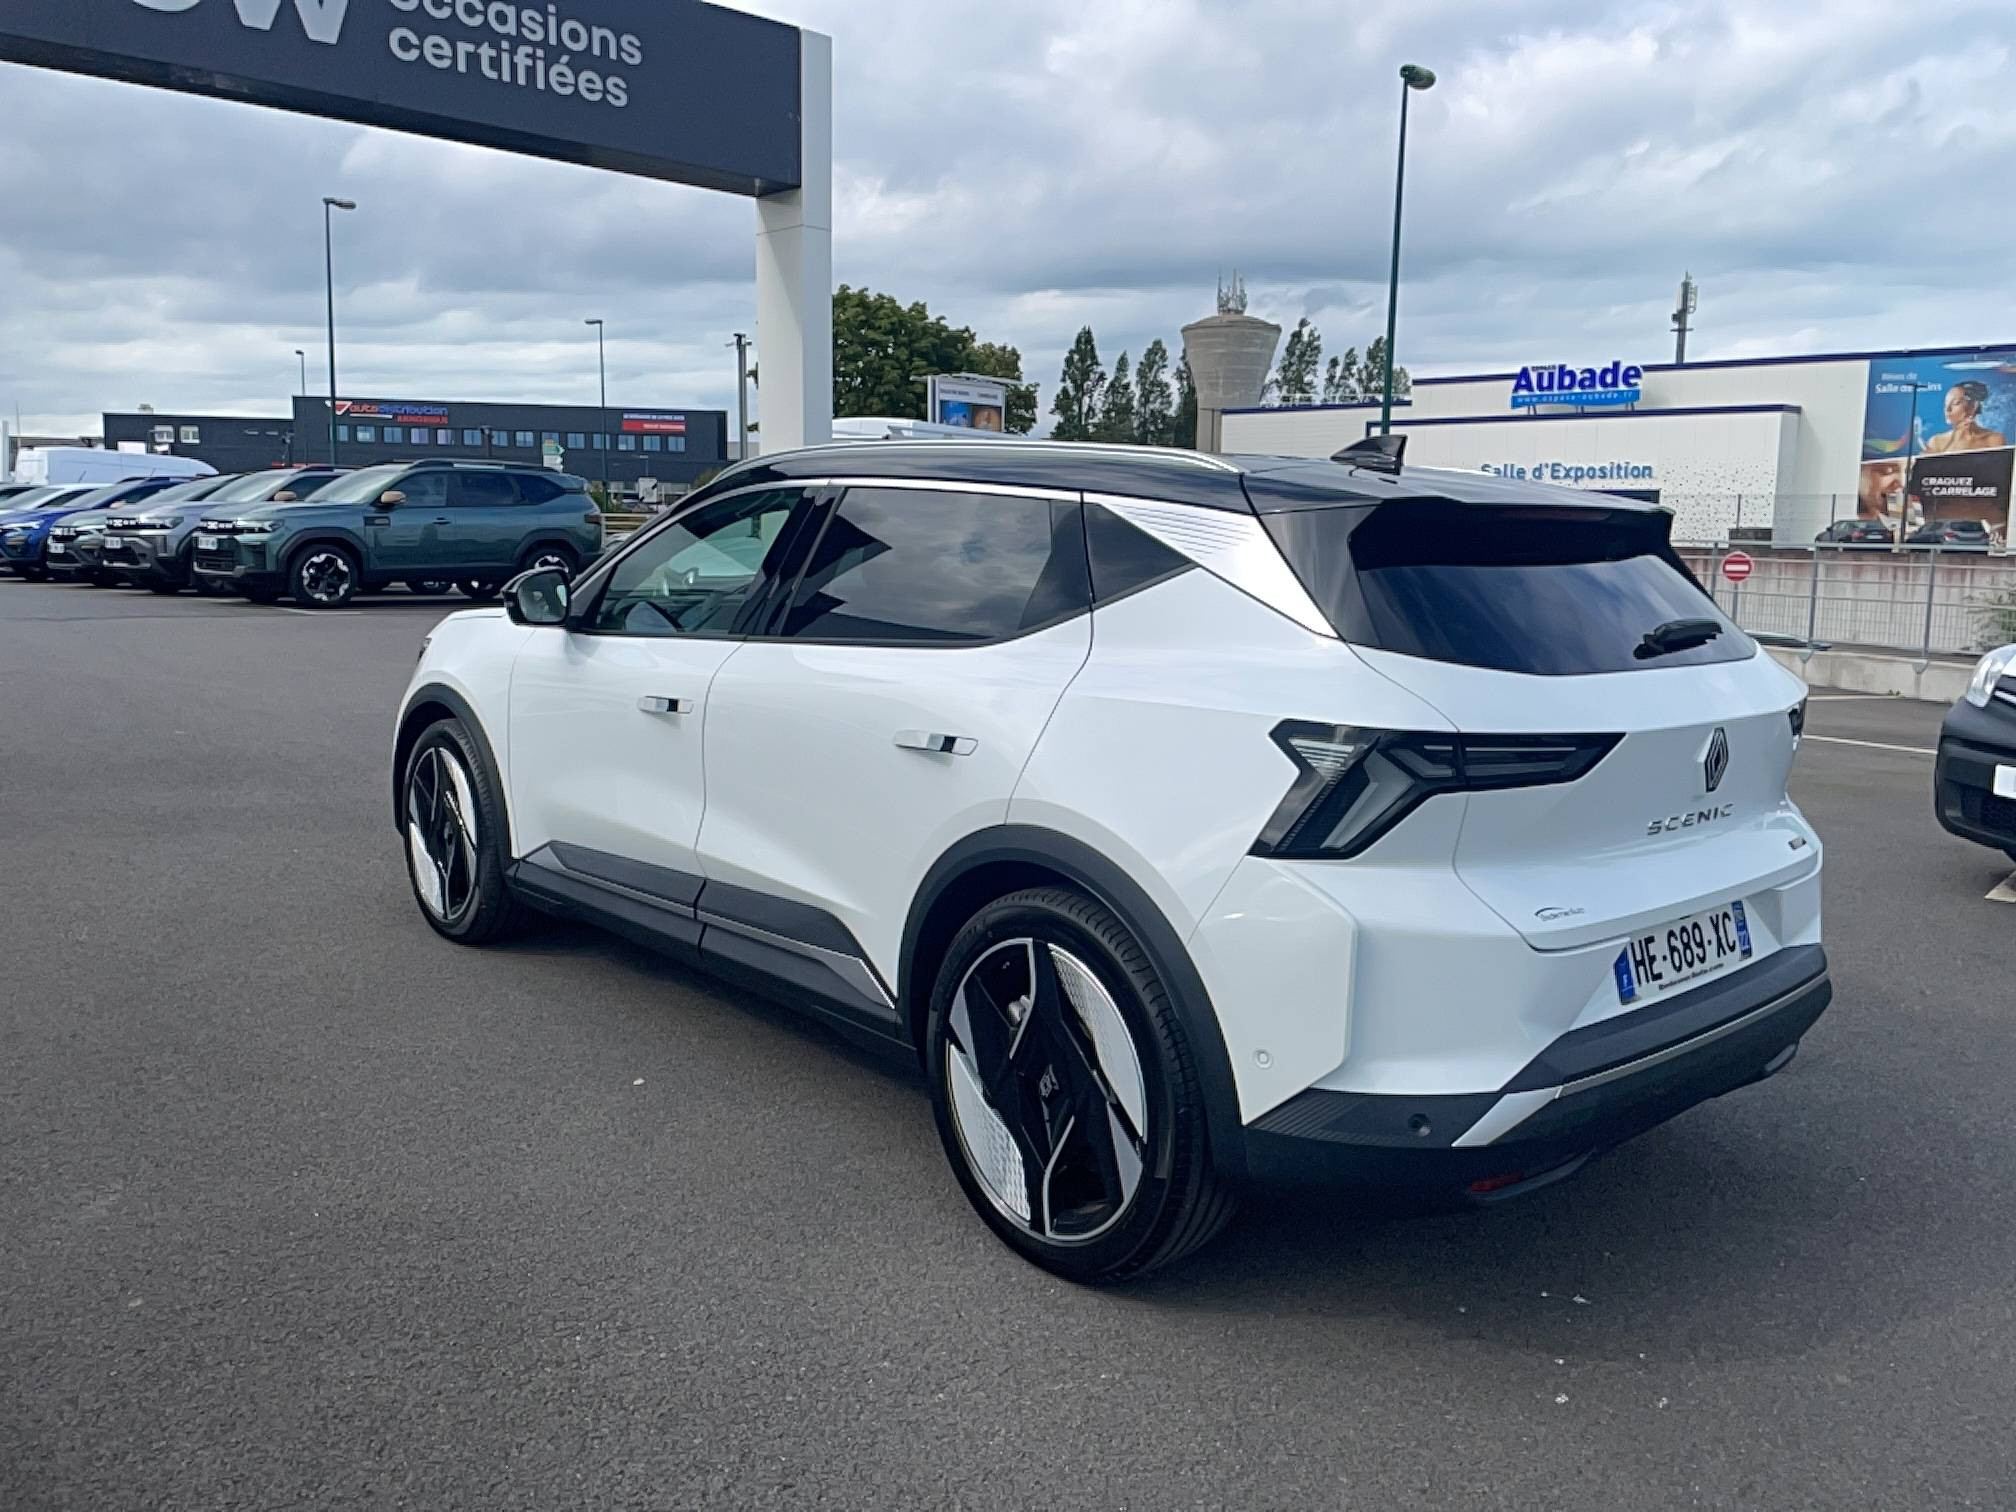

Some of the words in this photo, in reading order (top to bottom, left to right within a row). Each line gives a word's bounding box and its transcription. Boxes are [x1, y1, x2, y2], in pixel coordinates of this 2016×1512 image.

[388, 26, 629, 108] certifiées
[1512, 360, 1642, 394] Aubade
[1532, 462, 1653, 484] d'Exposition
[1931, 486, 1998, 497] CARRELAGE
[1647, 803, 1734, 836] SCENIC
